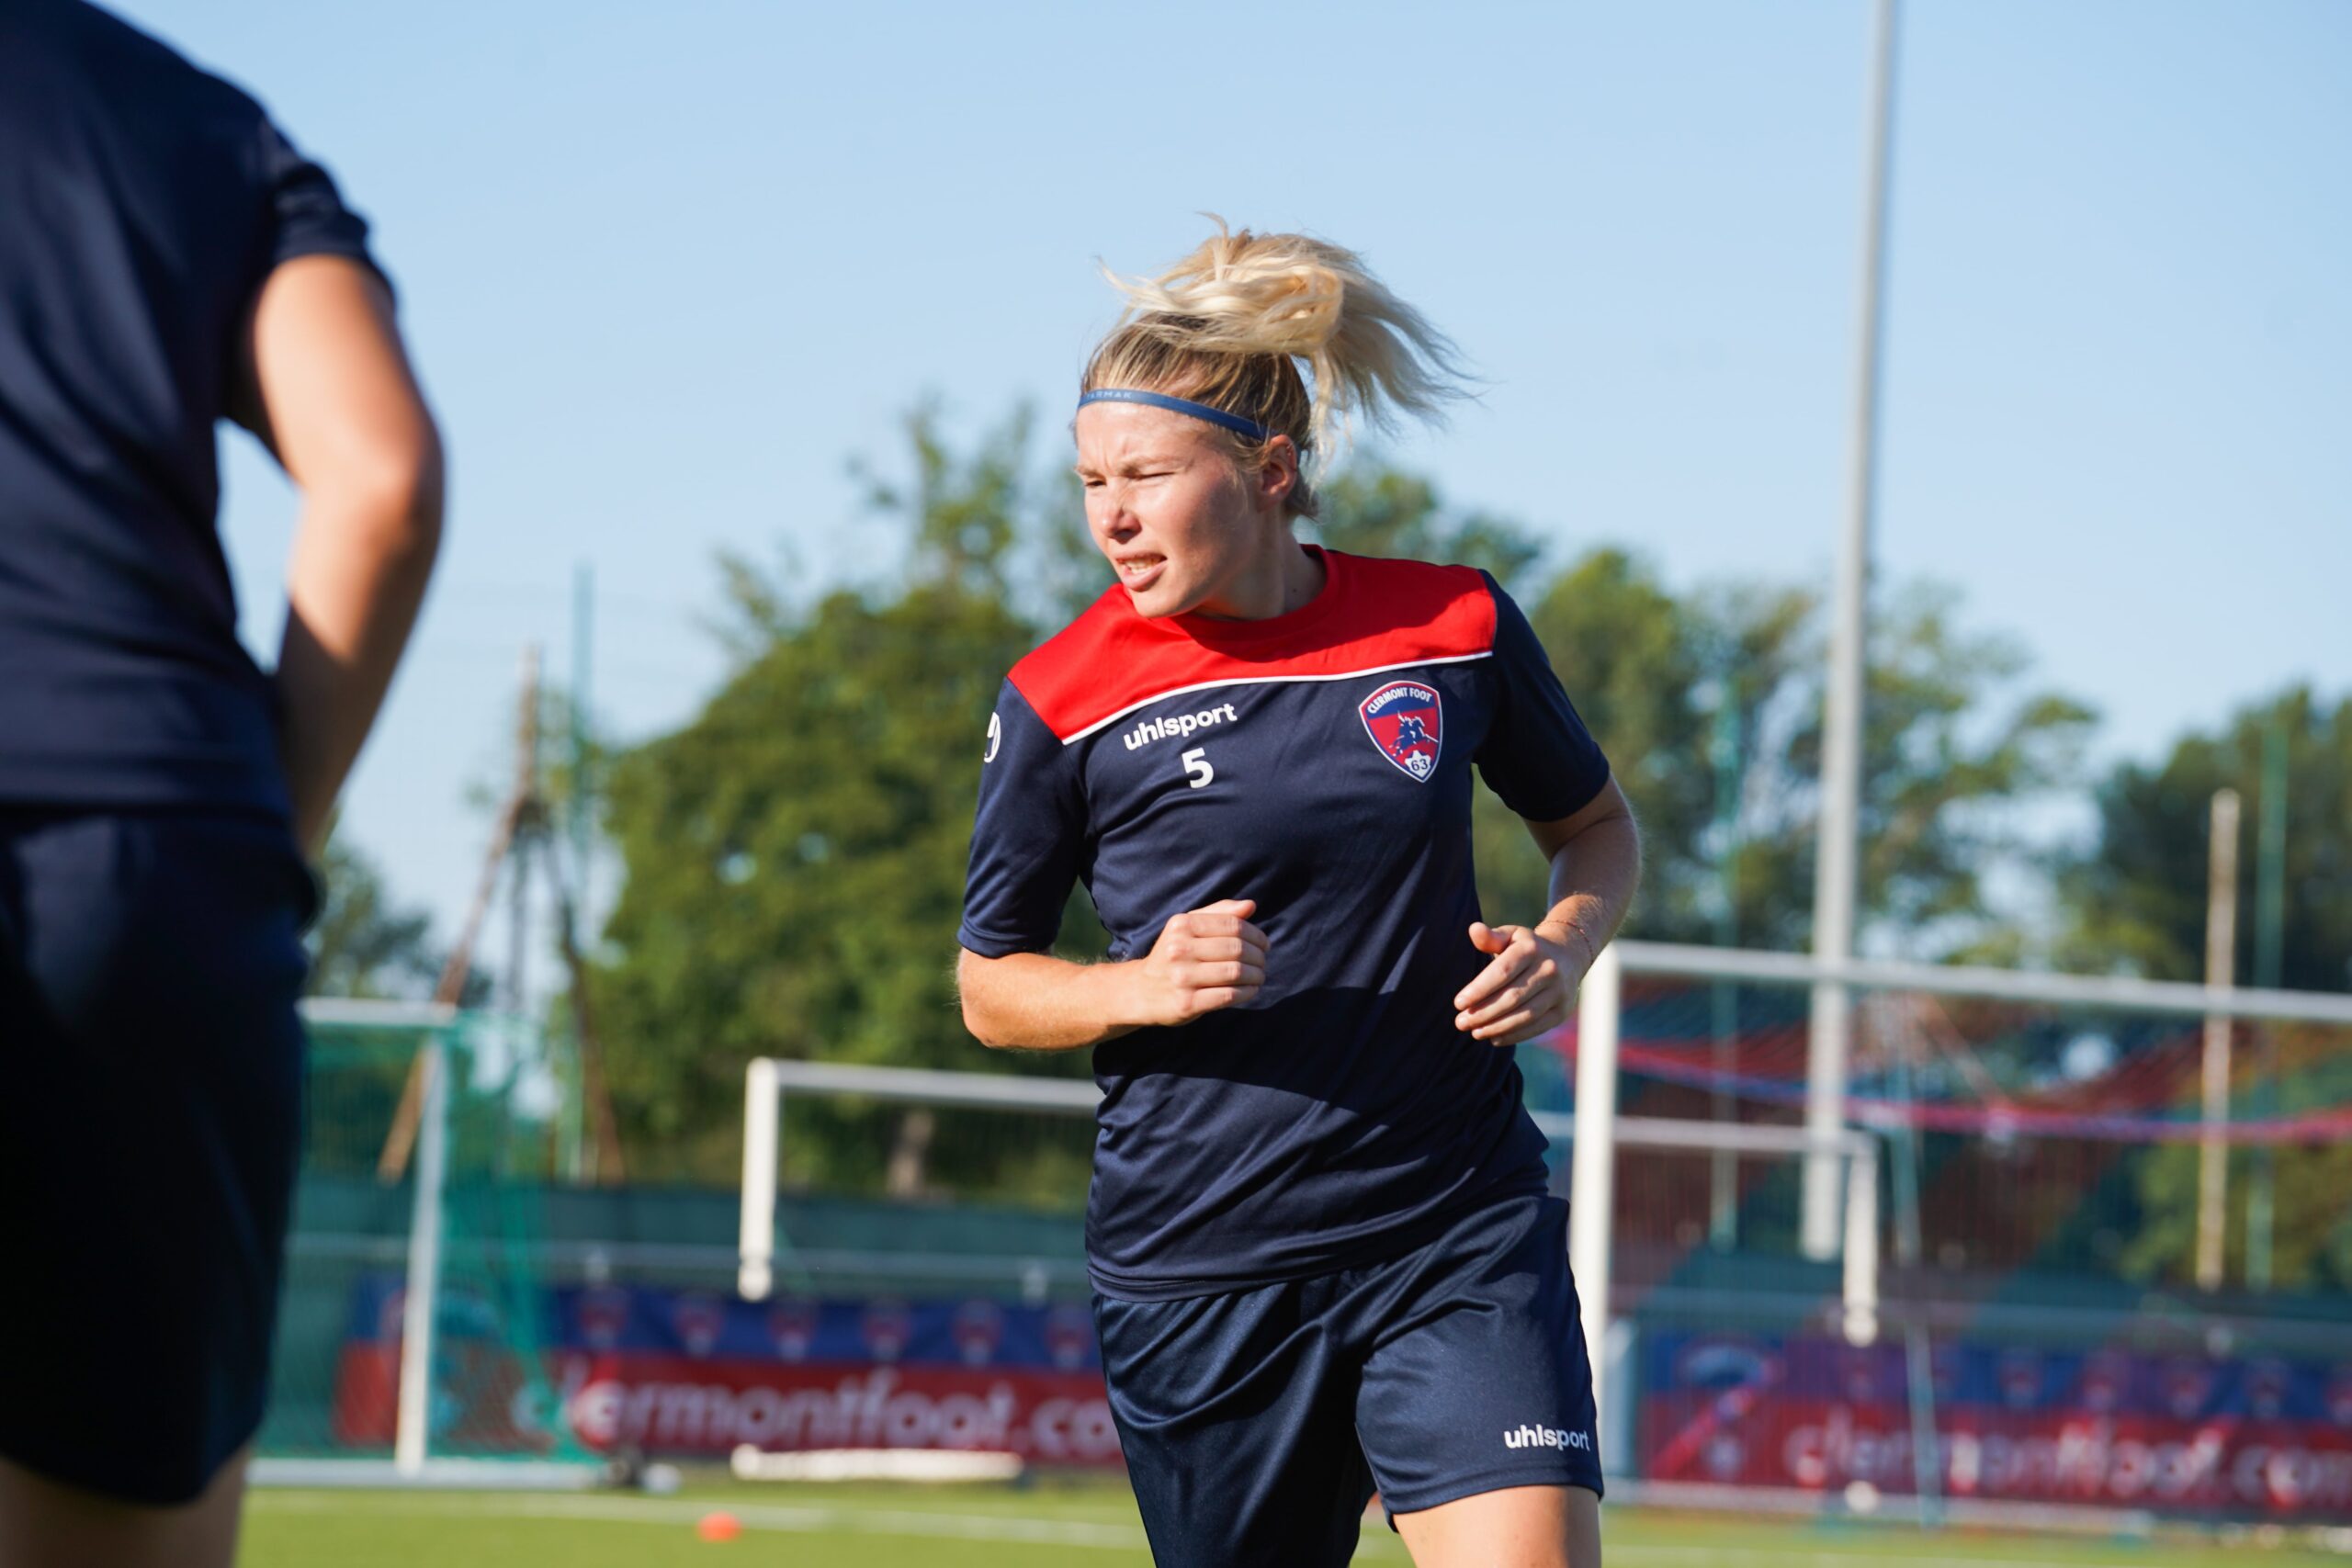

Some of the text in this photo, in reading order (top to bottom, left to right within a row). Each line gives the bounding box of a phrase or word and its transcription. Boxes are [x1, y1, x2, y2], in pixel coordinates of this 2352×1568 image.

[1366, 687, 1433, 714] CLERMONT FOOT
[1123, 703, 1238, 751] uhlsport
[1182, 747, 1215, 789] 5
[1410, 758, 1429, 772] 63
[1503, 1424, 1590, 1451] uhlsport
